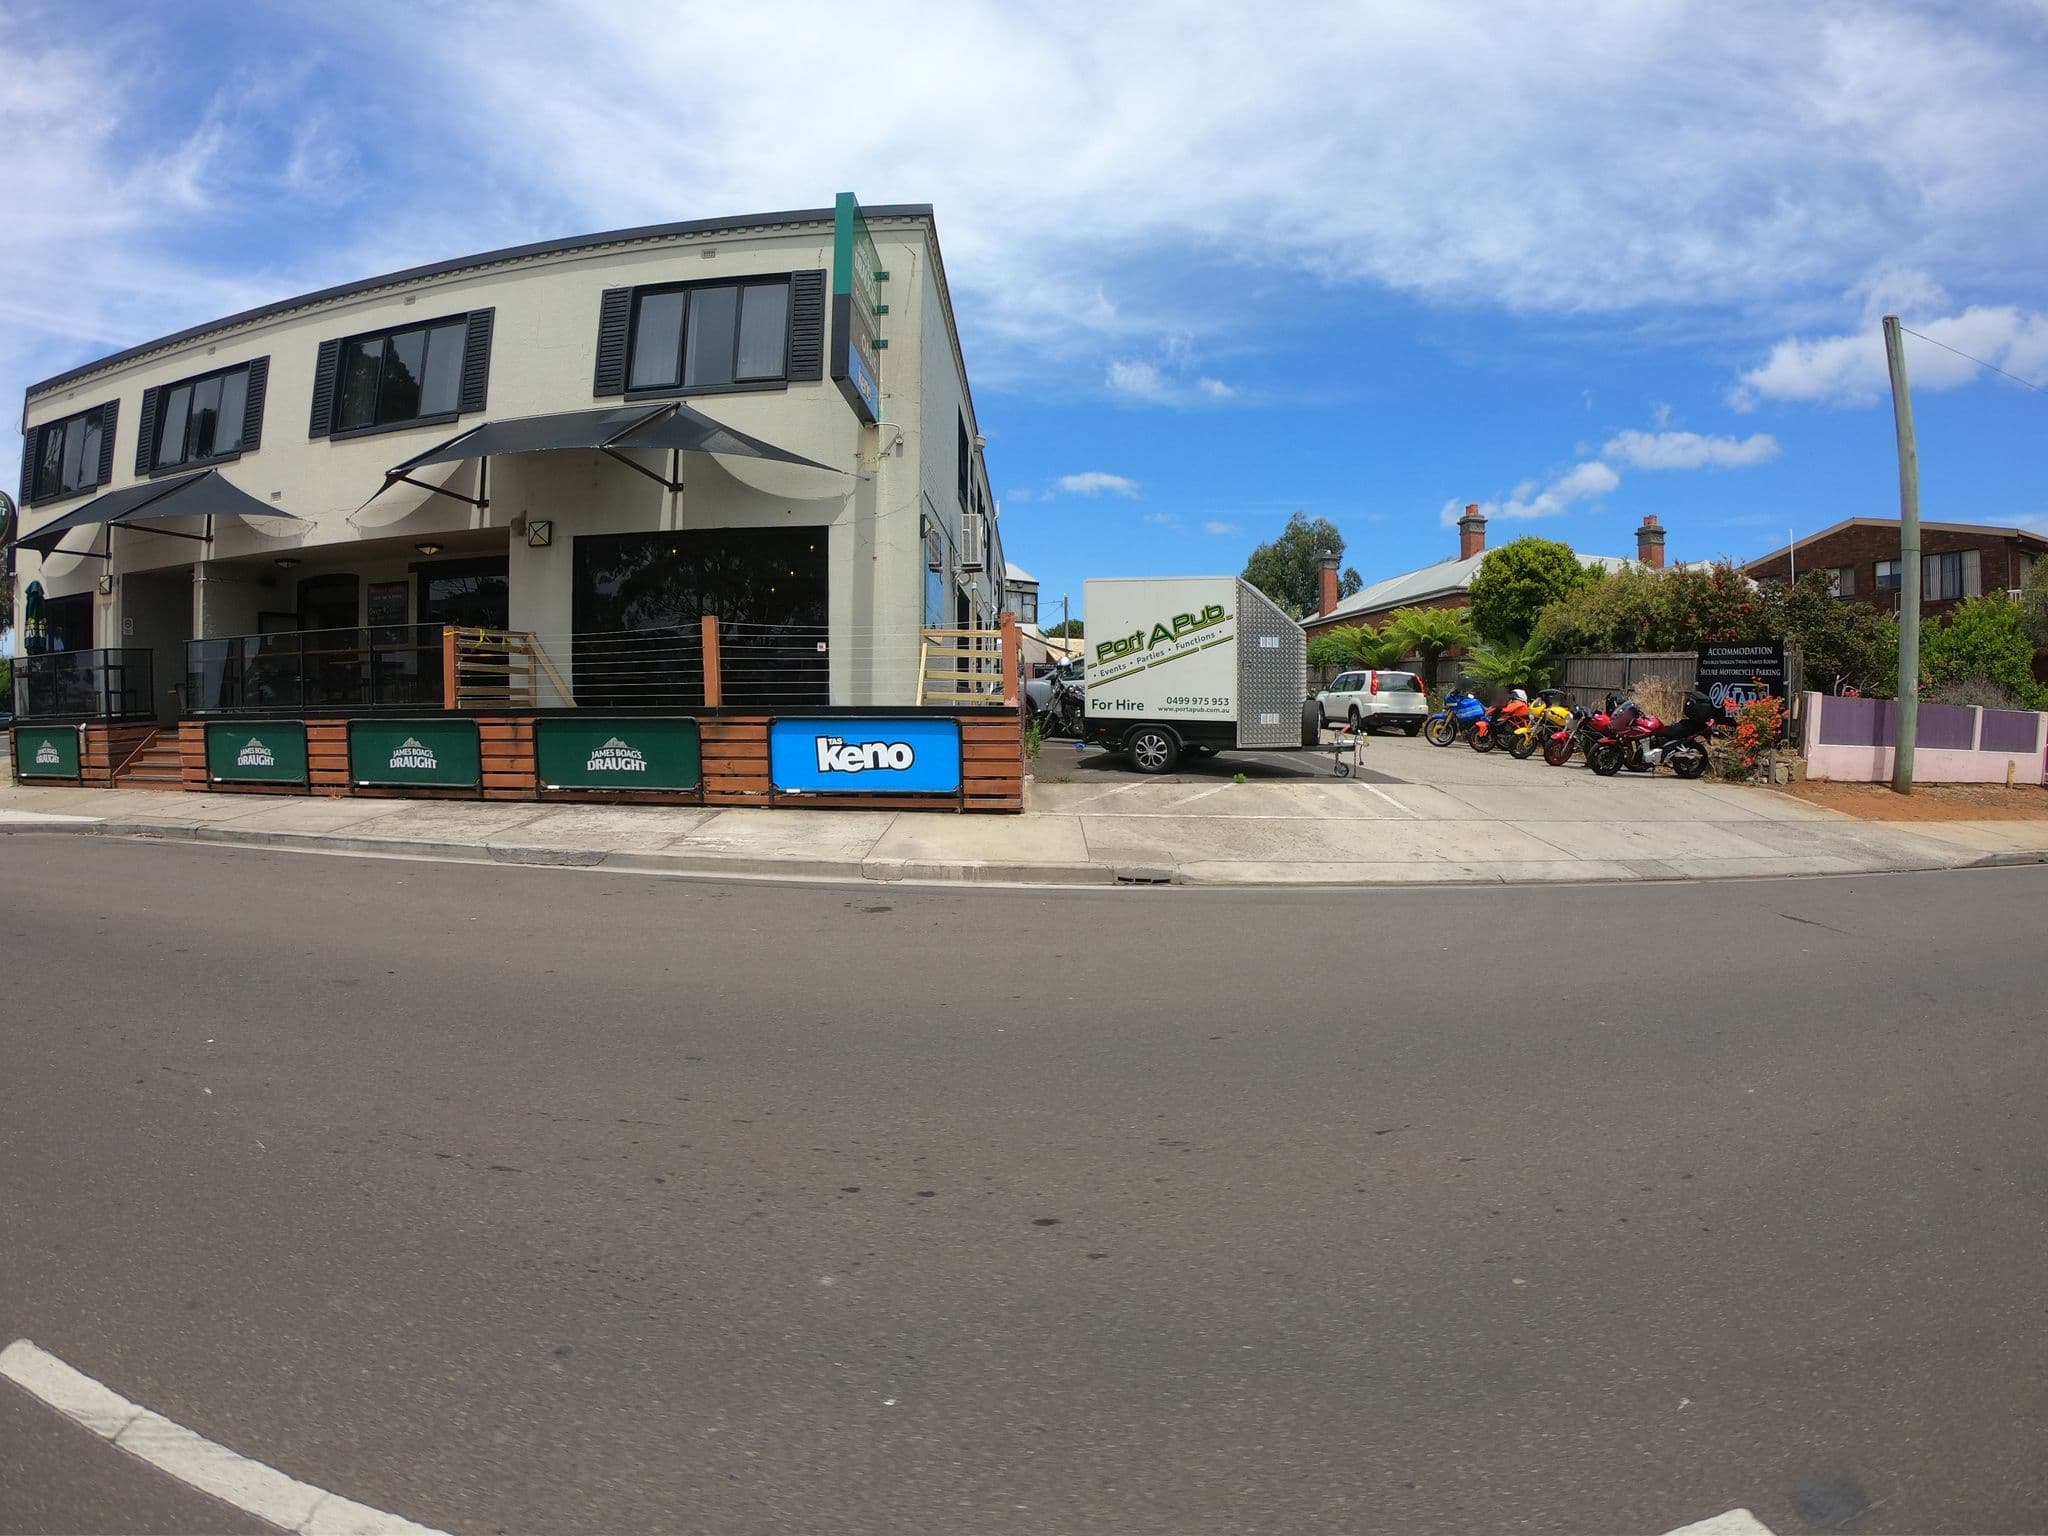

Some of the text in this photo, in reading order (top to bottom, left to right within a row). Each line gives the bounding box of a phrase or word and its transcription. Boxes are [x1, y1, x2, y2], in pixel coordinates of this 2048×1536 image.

[1096, 604, 1225, 661] Port A Pub
[1100, 632, 1216, 677] Events Parties Functions
[1707, 647, 1773, 656] ACCOMMODATION
[1700, 668, 1781, 676] SECURE MOTORCYCLE PARKING
[1091, 698, 1145, 711] For Hire
[1166, 696, 1230, 706] 0499 975 953
[1157, 706, 1230, 714] www.portapub.com.au
[392, 748, 412, 758] JAMES
[591, 749, 642, 760] JAMES BOAG'S
[816, 737, 914, 772] keno
[237, 755, 275, 766] DRAUGHT
[389, 756, 438, 769] DRAUGHT
[587, 758, 647, 771] DRAUGHT
